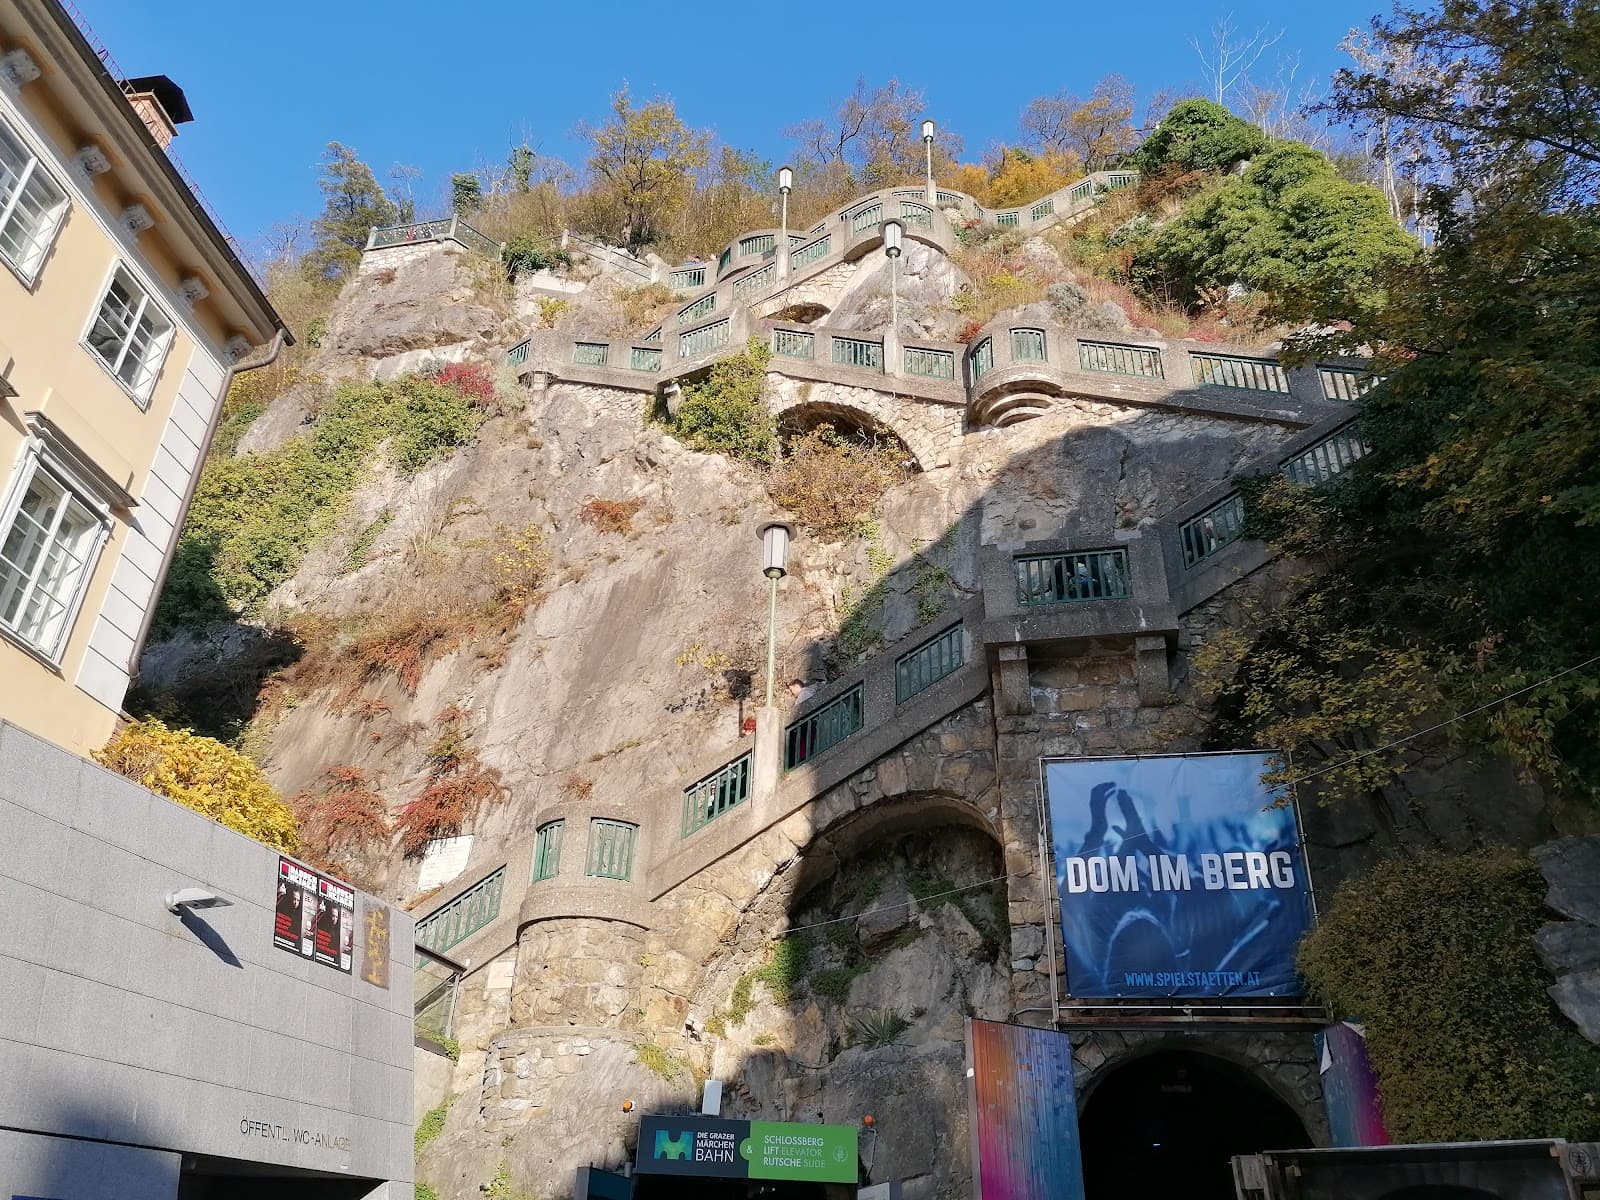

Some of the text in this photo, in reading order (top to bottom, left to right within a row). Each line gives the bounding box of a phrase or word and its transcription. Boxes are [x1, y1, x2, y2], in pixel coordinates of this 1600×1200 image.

[1066, 851, 1295, 893] DOM IM BERG
[1124, 971, 1261, 987] WWW.SPIELSTAETTEN.AT
[240, 1115, 290, 1142] ÖFFENTL.
[697, 1131, 735, 1140] DIE GRAZER
[764, 1135, 824, 1146] SCHLOSSBERG
[697, 1139, 734, 1149] MÄRCHEN
[746, 1145, 753, 1154] &
[696, 1149, 734, 1163] BAHN
[764, 1146, 823, 1158] LIFT ELEVATOR
[763, 1157, 826, 1168] RUTSCHE SLIDE
